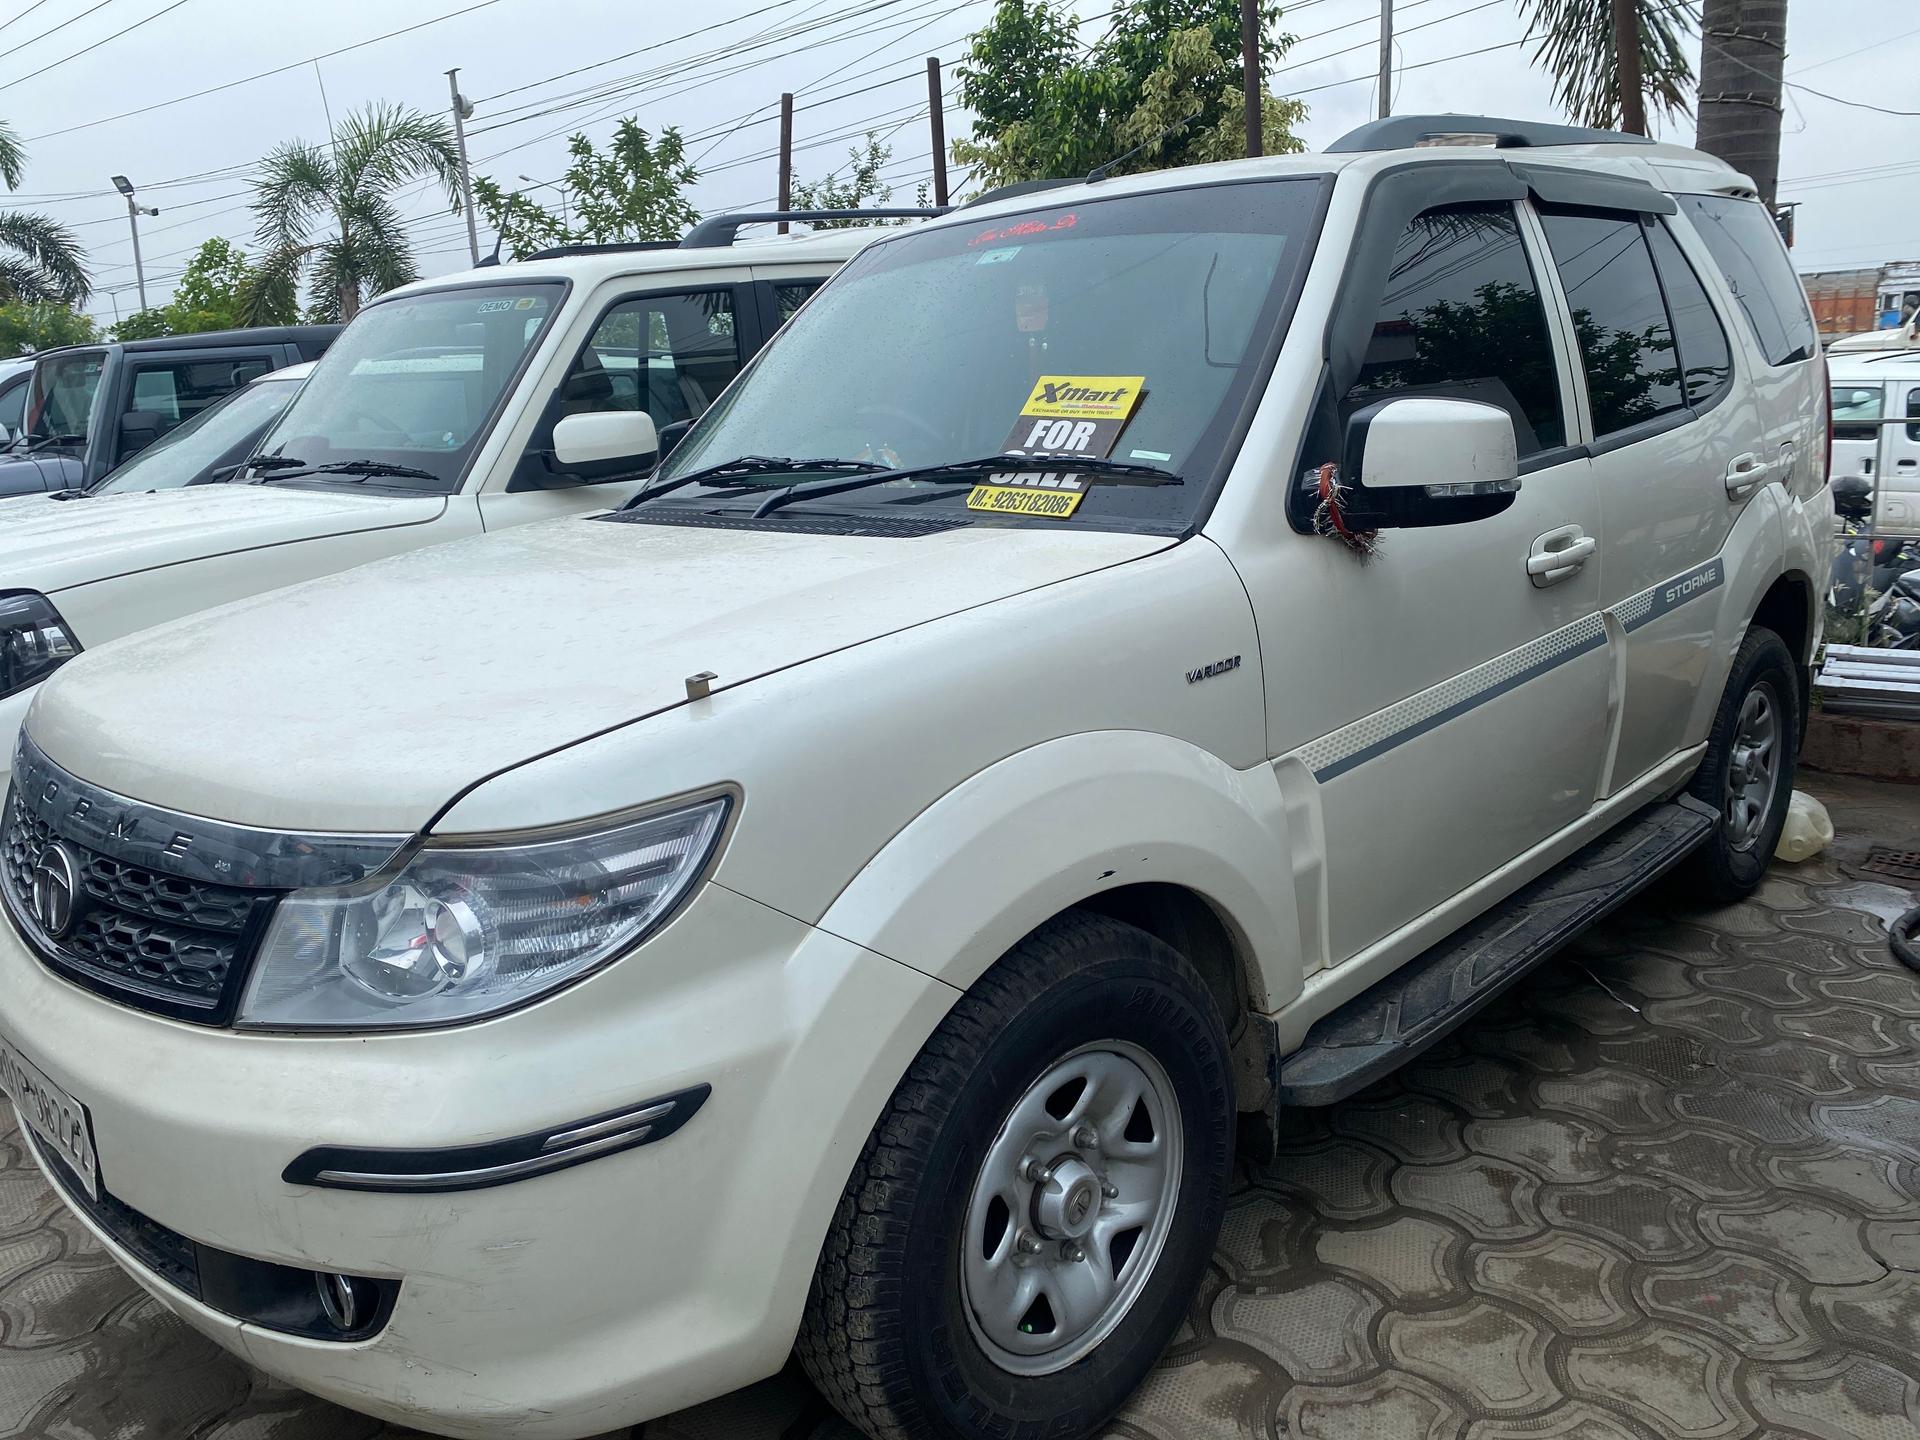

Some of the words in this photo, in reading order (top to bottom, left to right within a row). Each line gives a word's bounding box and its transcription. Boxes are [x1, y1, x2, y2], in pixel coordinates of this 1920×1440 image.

[480, 301, 511, 311] DEMO
[1035, 381, 1128, 403] Xmart
[1023, 419, 1097, 452] FOR
[992, 492, 1073, 514] 9263182086
[1665, 567, 1717, 603] STORME
